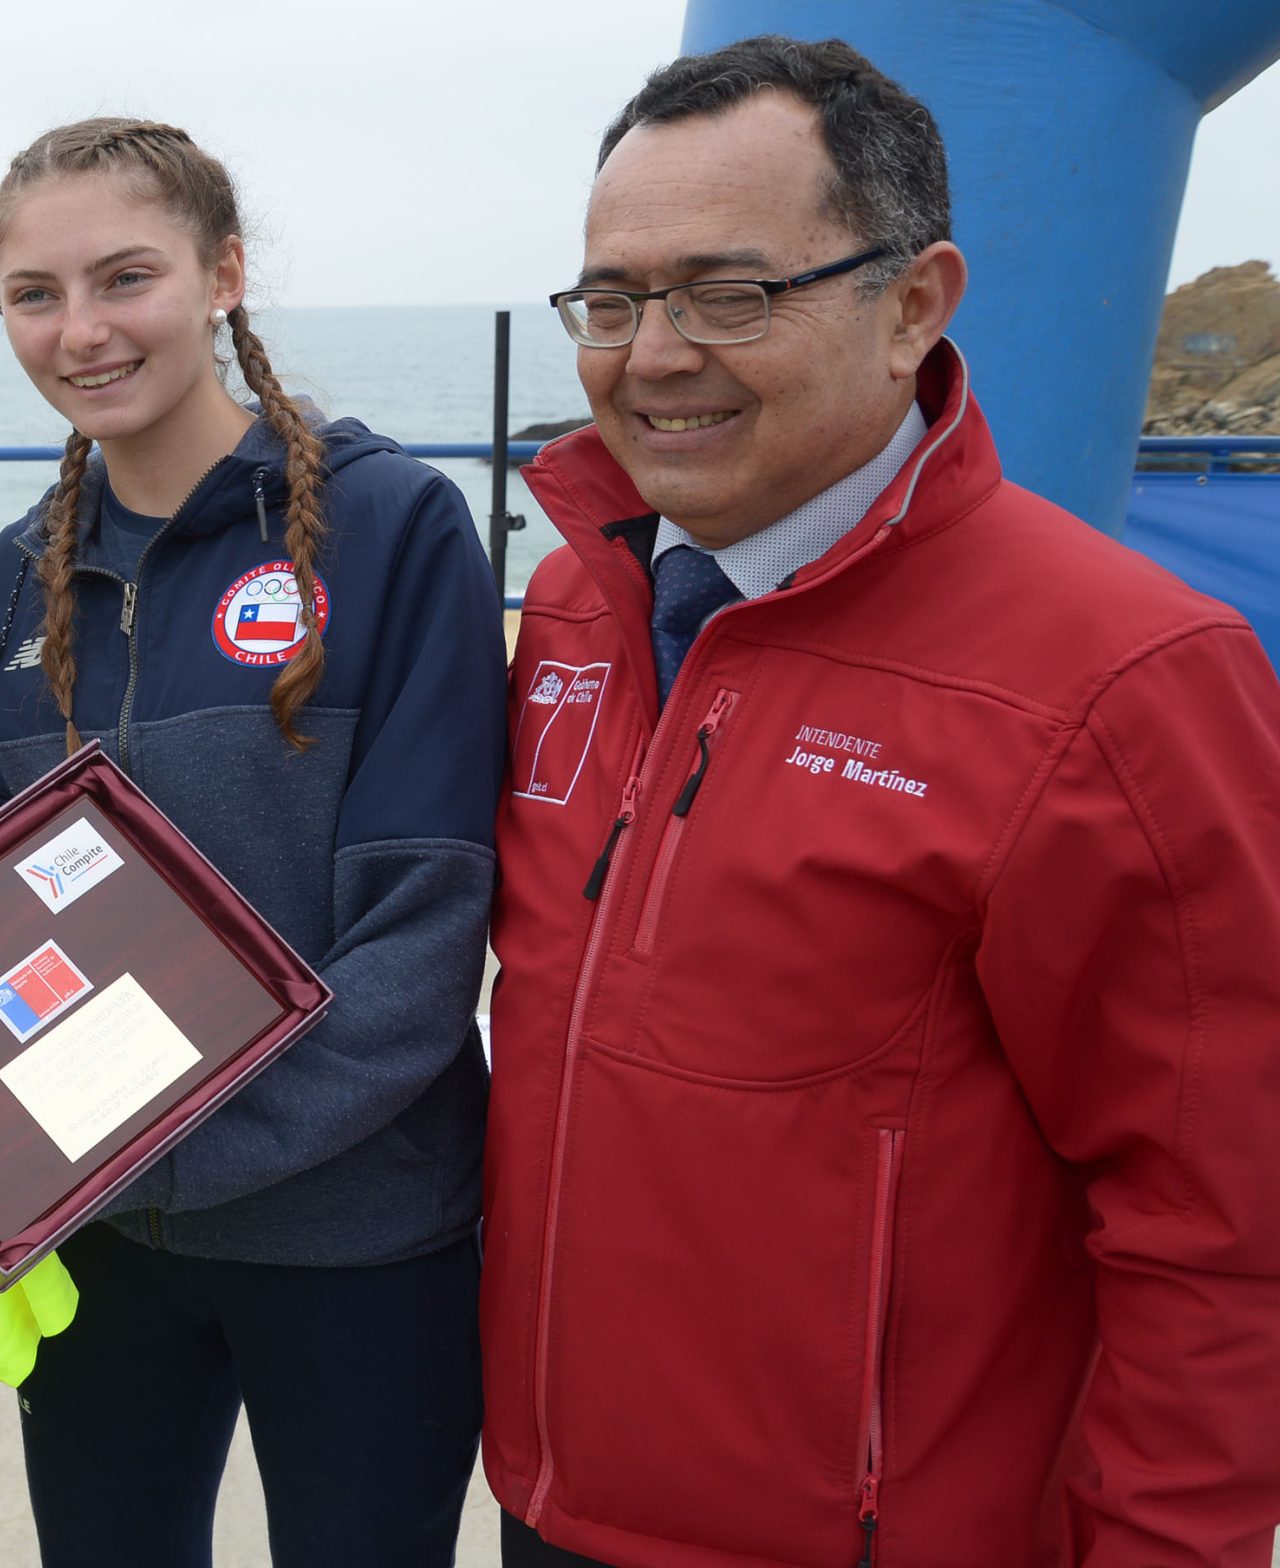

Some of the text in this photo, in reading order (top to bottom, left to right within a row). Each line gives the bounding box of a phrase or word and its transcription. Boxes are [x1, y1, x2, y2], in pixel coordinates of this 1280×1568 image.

[235, 651, 287, 664] CHILE
[795, 725, 882, 759] INTENDENTE
[785, 746, 928, 797] Jorge Martínez
[54, 847, 80, 867] Chile
[62, 845, 104, 876] Compite
